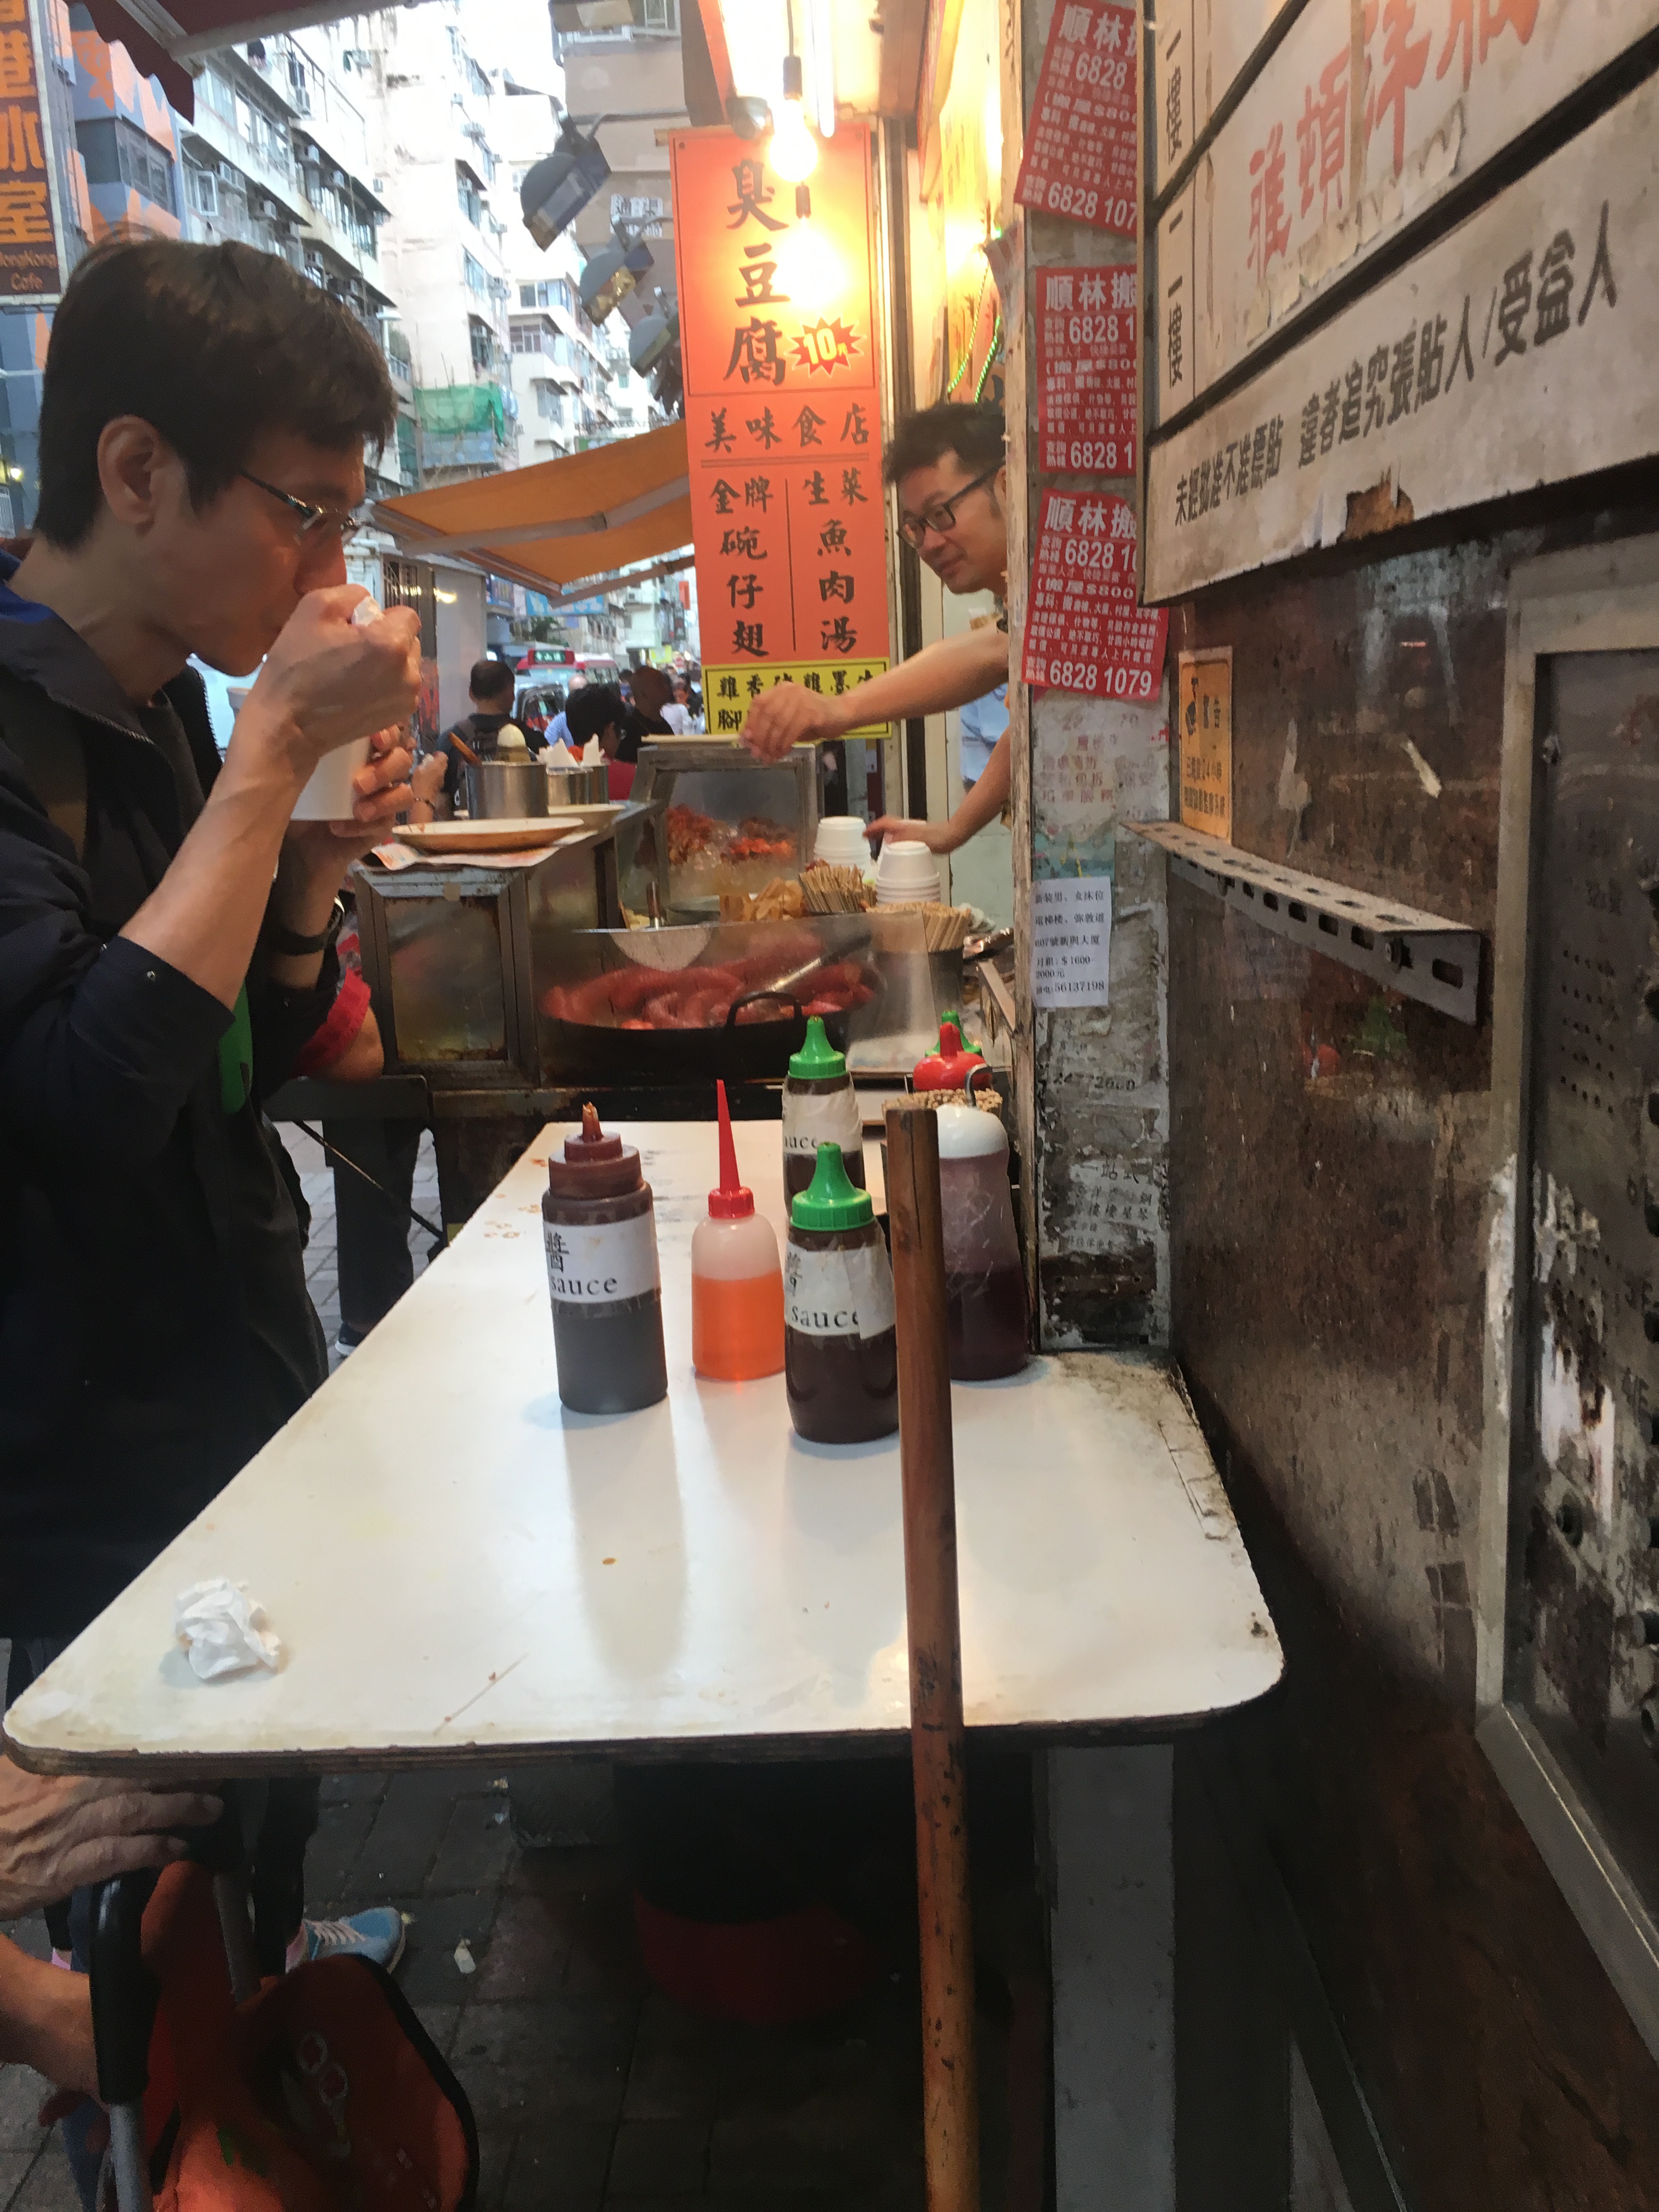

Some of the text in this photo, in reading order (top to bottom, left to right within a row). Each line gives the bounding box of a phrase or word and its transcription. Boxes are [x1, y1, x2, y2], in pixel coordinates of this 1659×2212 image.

[1075, 52, 1127, 89] 6828
[1048, 180, 1098, 219] 6828
[723, 159, 791, 386] 臭豆腐
[1069, 314, 1119, 344] 6828
[704, 403, 870, 453] 美味食店
[1070, 441, 1118, 470] 6828
[1065, 538, 1114, 569] 6828
[1050, 658, 1152, 697] 6828 1079
[550, 1276, 617, 1295] sauce
